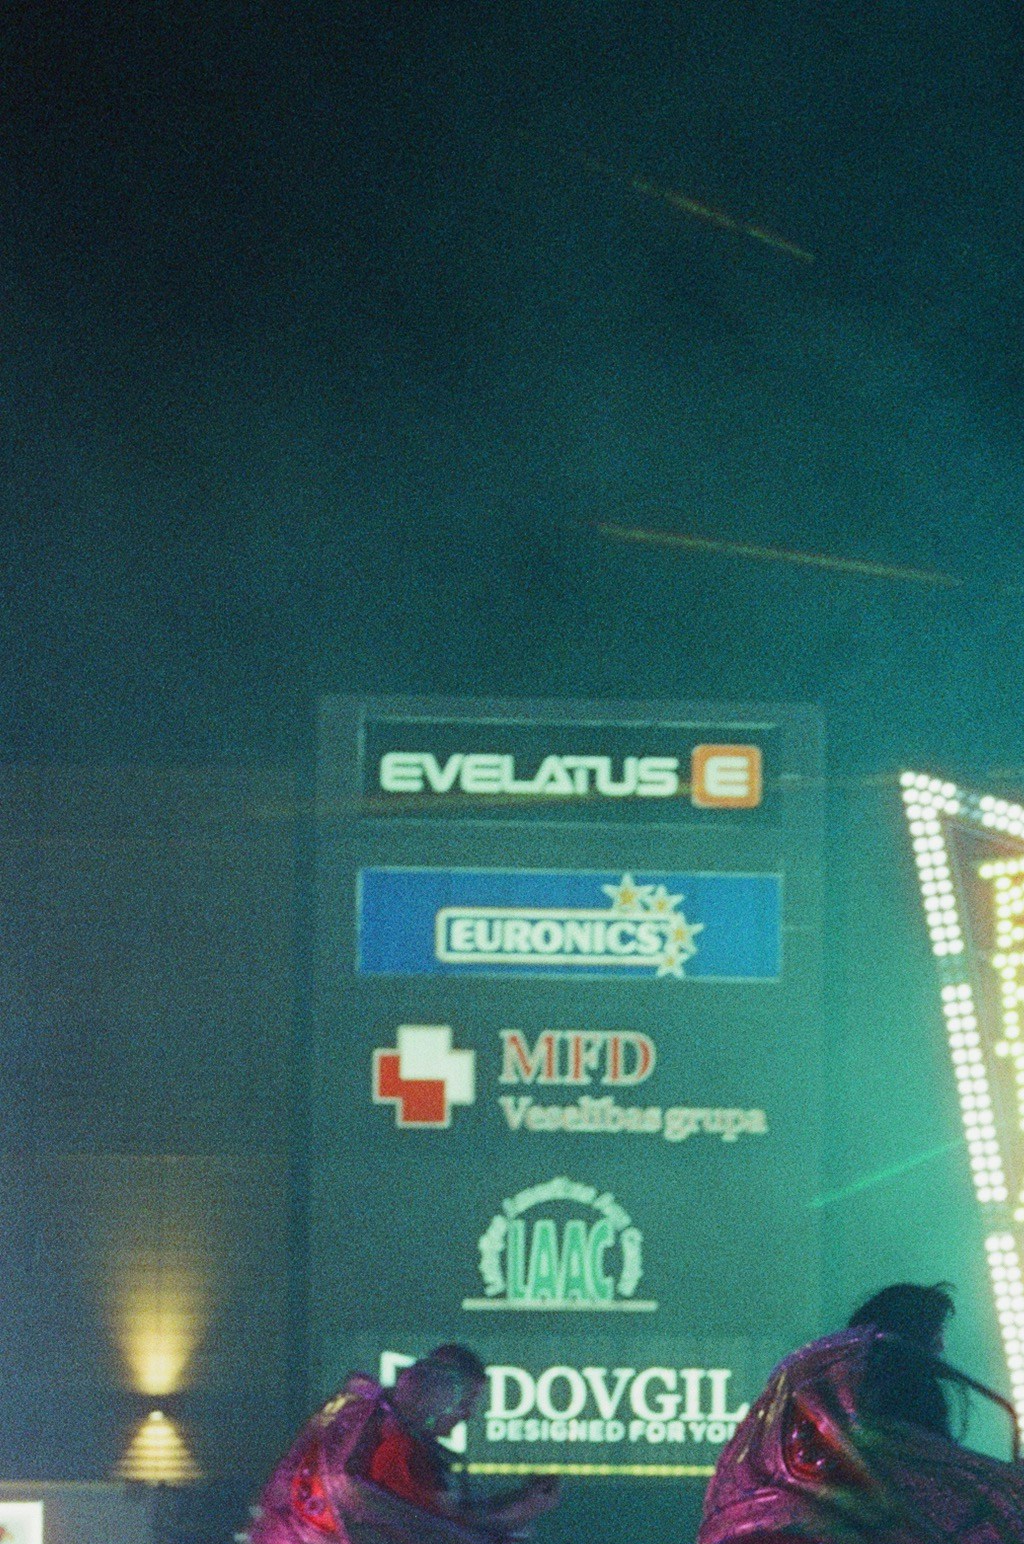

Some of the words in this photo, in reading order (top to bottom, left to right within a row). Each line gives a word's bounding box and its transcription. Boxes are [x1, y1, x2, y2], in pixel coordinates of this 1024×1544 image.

[379, 751, 681, 798] EVELATUS
[449, 918, 661, 957] EURONICS
[498, 1029, 657, 1085] MFD
[663, 1106, 769, 1142] grupa
[506, 1218, 614, 1301] LAAC
[484, 1364, 750, 1423] DOVGIL
[485, 1418, 626, 1443] DESIGNED
[628, 1421, 688, 1444] FOR
